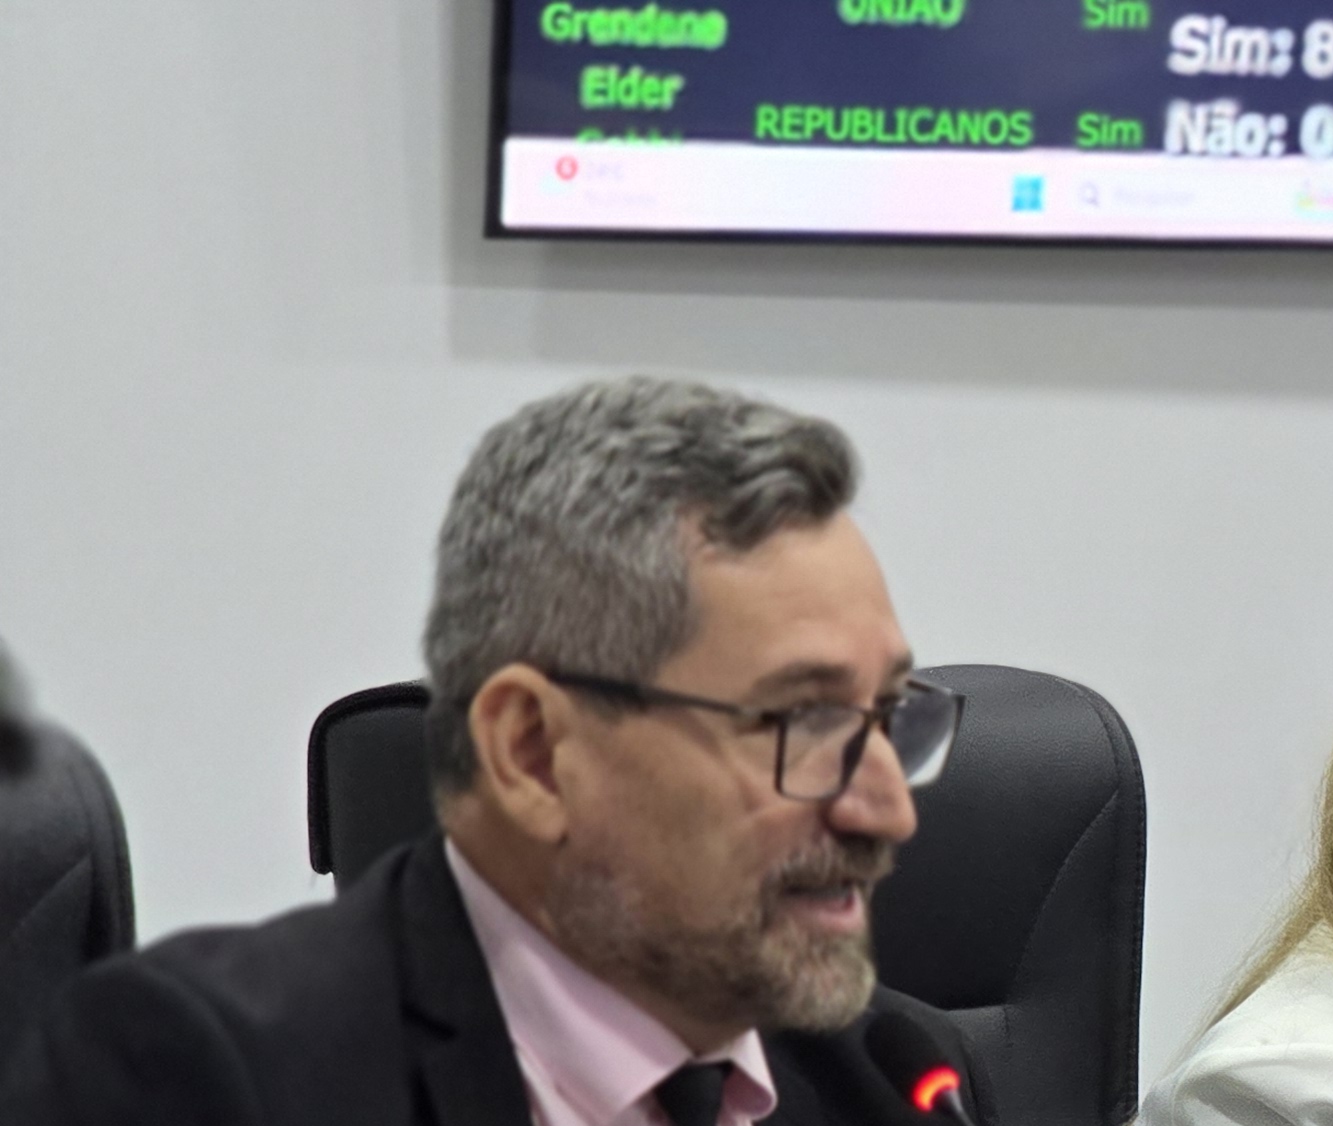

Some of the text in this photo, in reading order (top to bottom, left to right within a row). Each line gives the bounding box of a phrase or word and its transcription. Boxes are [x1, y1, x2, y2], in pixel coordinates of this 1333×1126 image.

[1083, 0, 1150, 30] Sim
[1167, 14, 1295, 78] Sim:
[579, 64, 686, 110] Elder
[755, 103, 1033, 145] REPUBLICANOS
[1076, 112, 1143, 147] Sim
[1163, 98, 1289, 158] Não:
